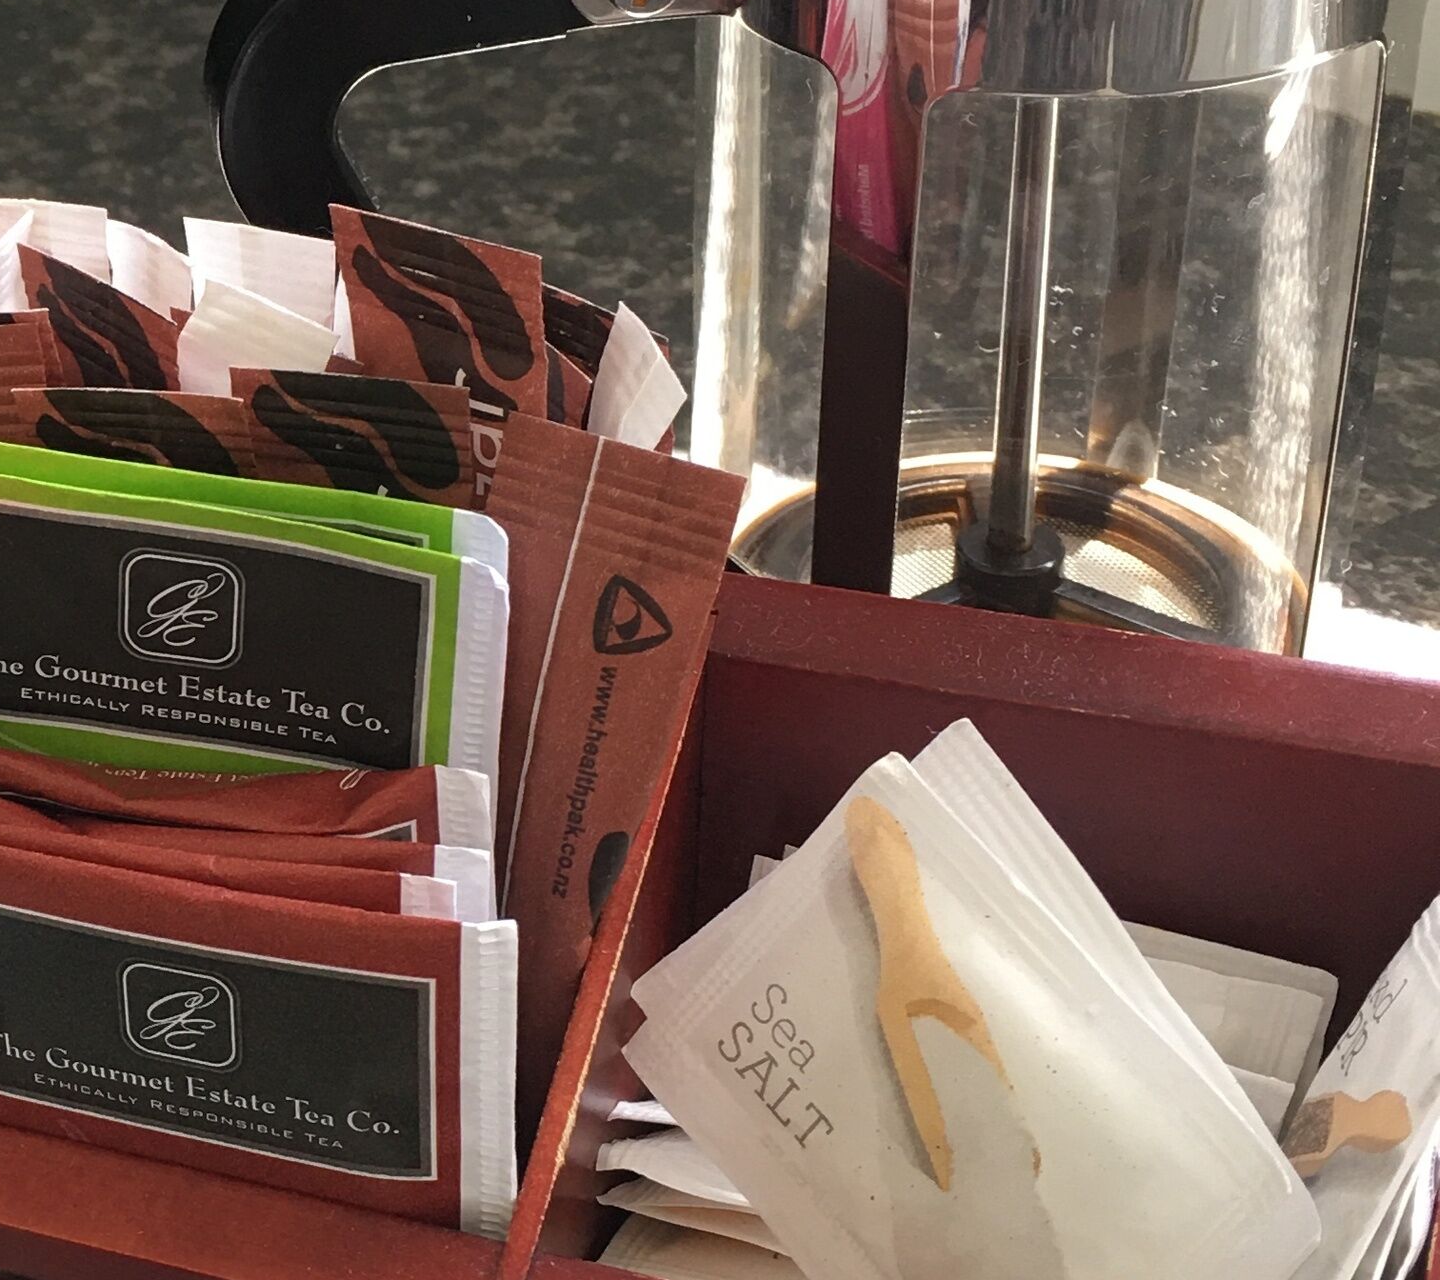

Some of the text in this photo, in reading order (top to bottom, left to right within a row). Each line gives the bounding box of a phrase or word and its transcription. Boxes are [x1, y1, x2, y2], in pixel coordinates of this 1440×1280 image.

[21, 687, 337, 745] ETHICALLY RESPONSIBLE TEA
[35, 655, 167, 696] Gourmet
[178, 675, 272, 710] Estate
[281, 688, 330, 720] Tea
[341, 702, 391, 735] Co.
[551, 666, 618, 900] www.healthpak.co.nz
[752, 984, 815, 1074] Sea
[34, 1073, 343, 1150] ETHICALLY RESPONSIBLE TEA
[46, 1047, 175, 1093] Gourmet
[187, 1077, 276, 1114] Estate
[285, 1096, 335, 1127] Tea
[347, 1110, 400, 1135] Co.
[718, 1022, 834, 1149] SALT
